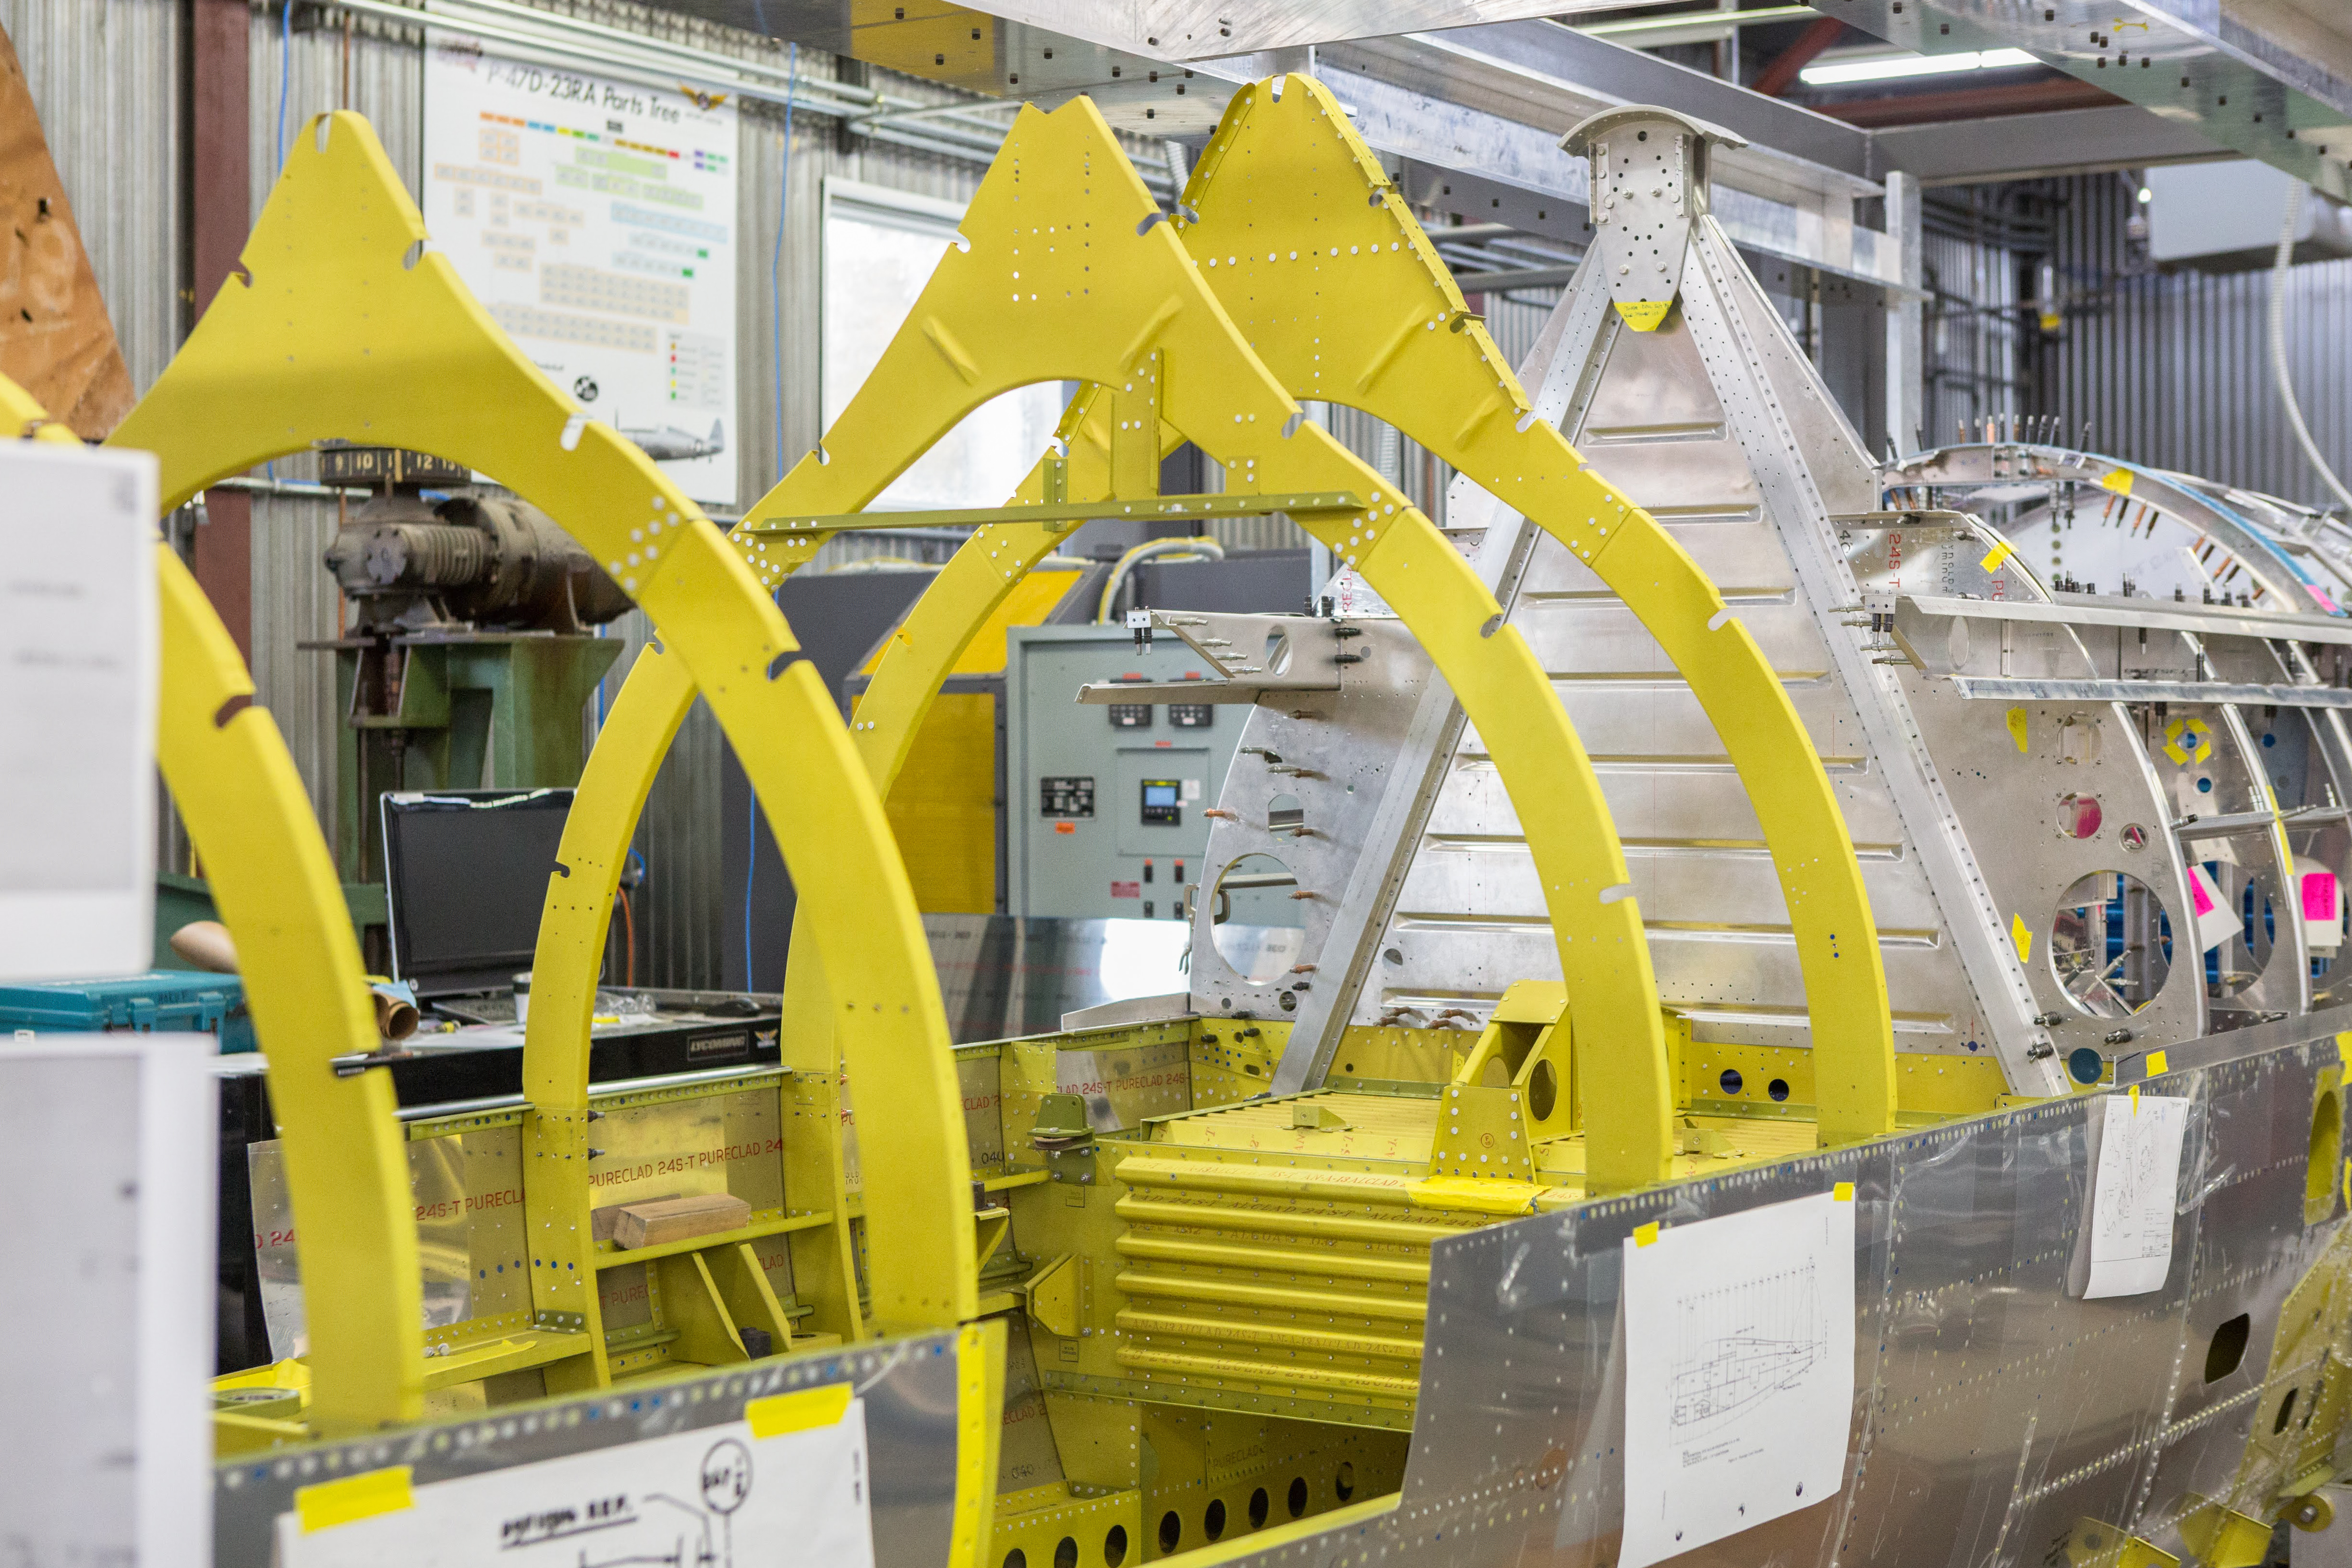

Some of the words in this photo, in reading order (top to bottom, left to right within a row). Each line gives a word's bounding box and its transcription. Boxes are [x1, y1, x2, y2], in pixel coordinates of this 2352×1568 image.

[603, 85, 643, 115] Parts
[649, 95, 679, 123] Tree
[1889, 534, 1901, 588] 24S-T
[1082, 1081, 1113, 1095] 24S-T
[1116, 1074, 1163, 1091] PURECLAD
[658, 1155, 695, 1175] 24S-T
[700, 1142, 761, 1167] PURECLAD
[416, 1200, 461, 1221] 24S-T
